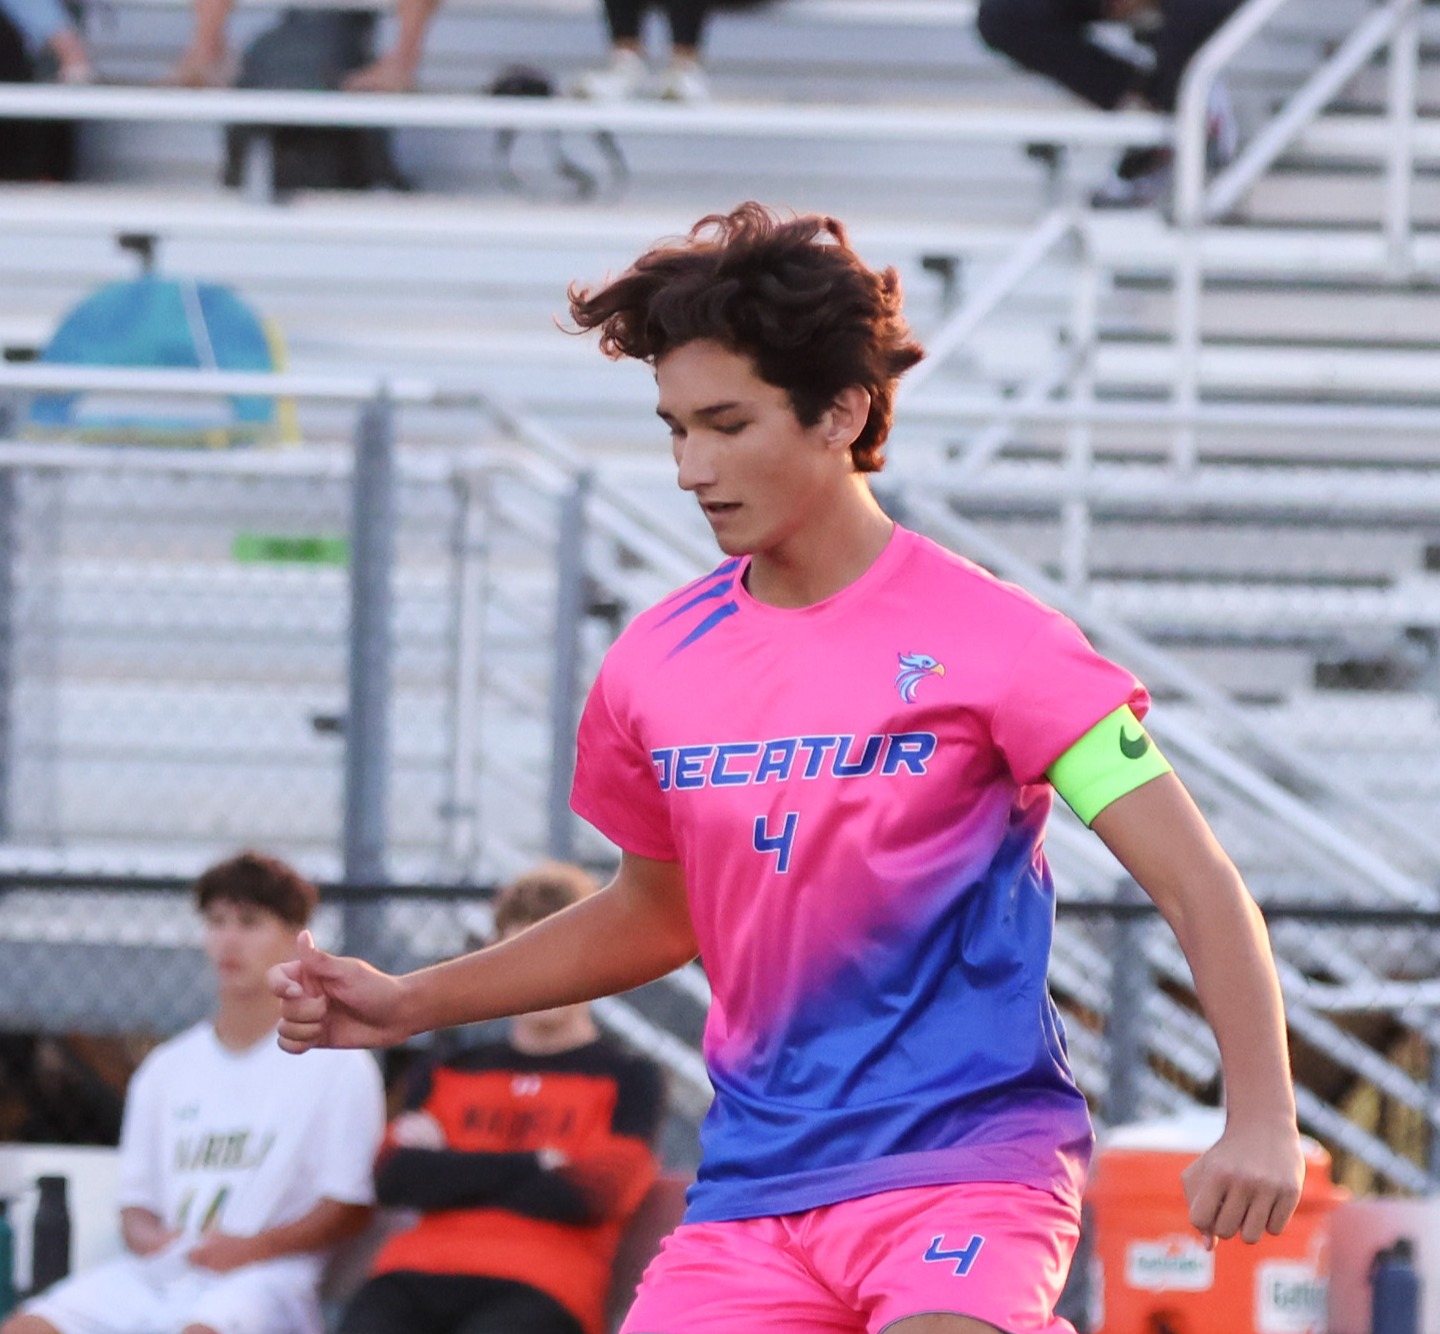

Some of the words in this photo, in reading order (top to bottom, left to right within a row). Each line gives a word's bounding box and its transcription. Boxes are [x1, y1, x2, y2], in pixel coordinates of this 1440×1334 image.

[651, 732, 937, 791] DECATUR
[753, 811, 799, 874] 4
[923, 1234, 985, 1276] 4
